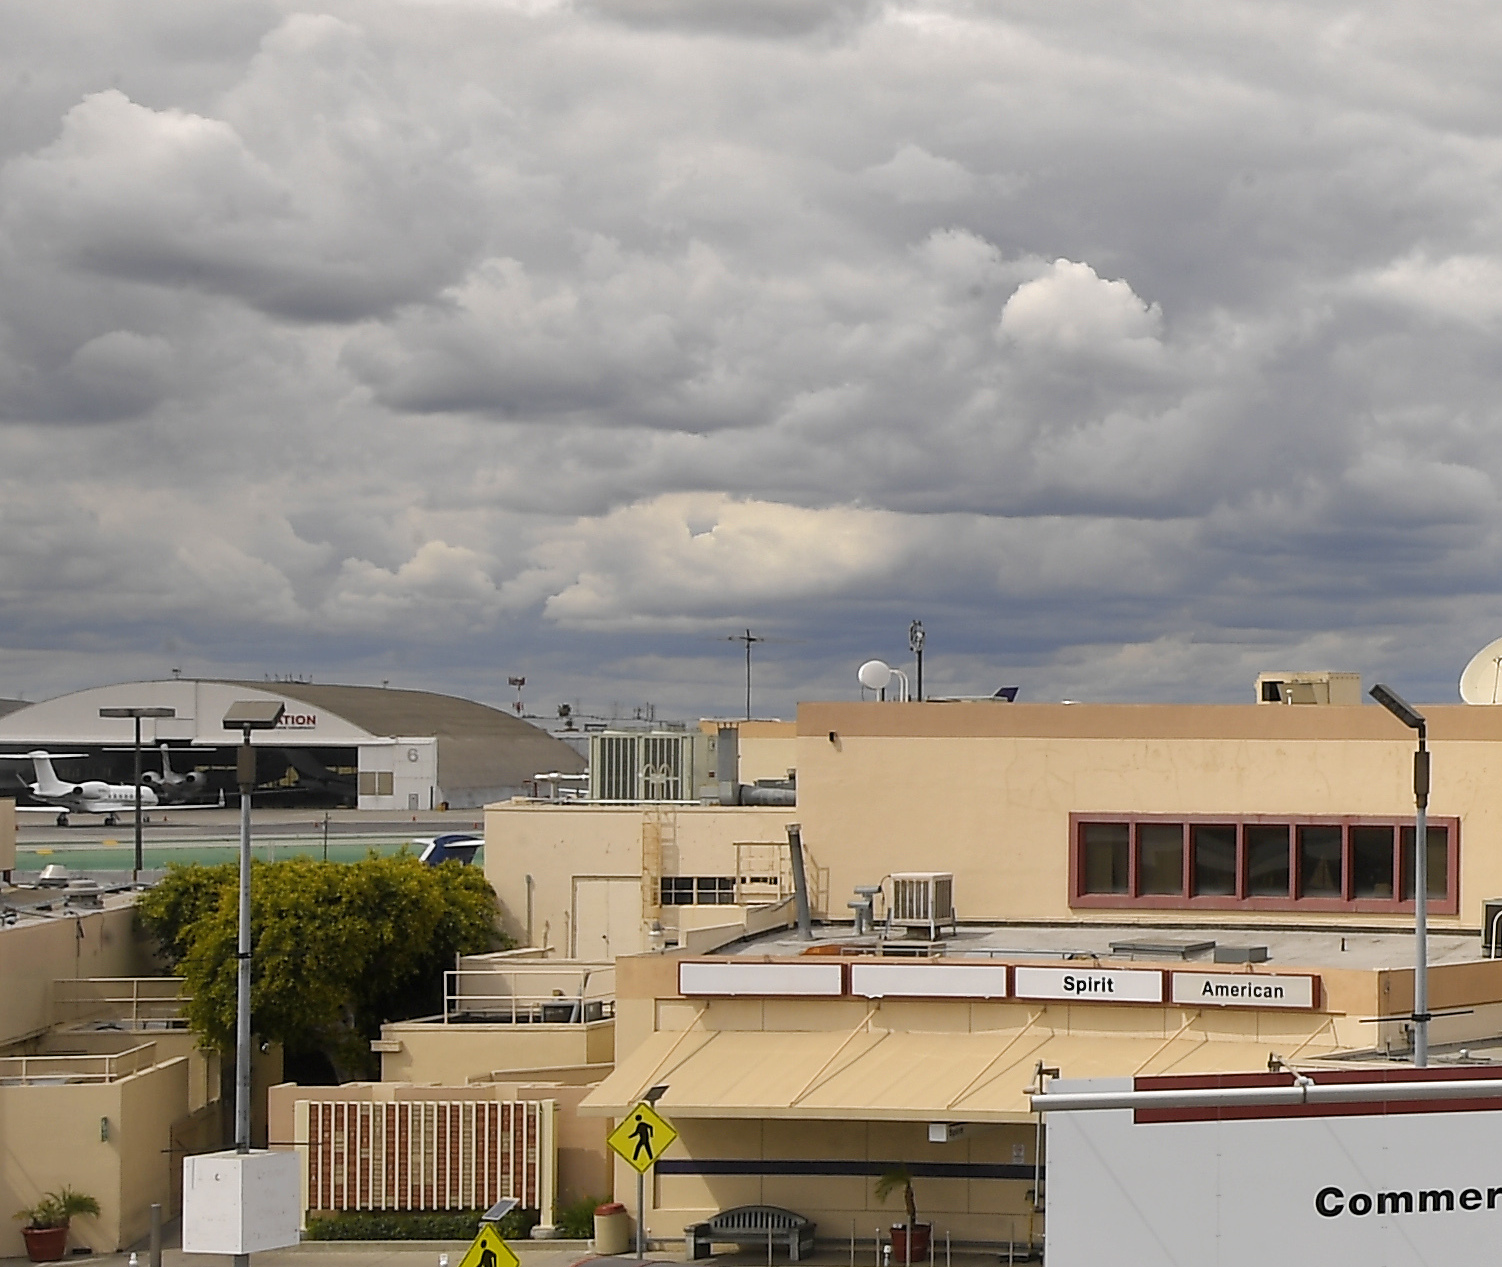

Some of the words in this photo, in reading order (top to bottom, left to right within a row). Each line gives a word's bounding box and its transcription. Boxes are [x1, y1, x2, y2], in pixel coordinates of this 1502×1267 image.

[276, 705, 316, 725] ATION
[408, 748, 419, 762] 6
[1063, 973, 1114, 996] Spirit
[1202, 980, 1284, 999] American
